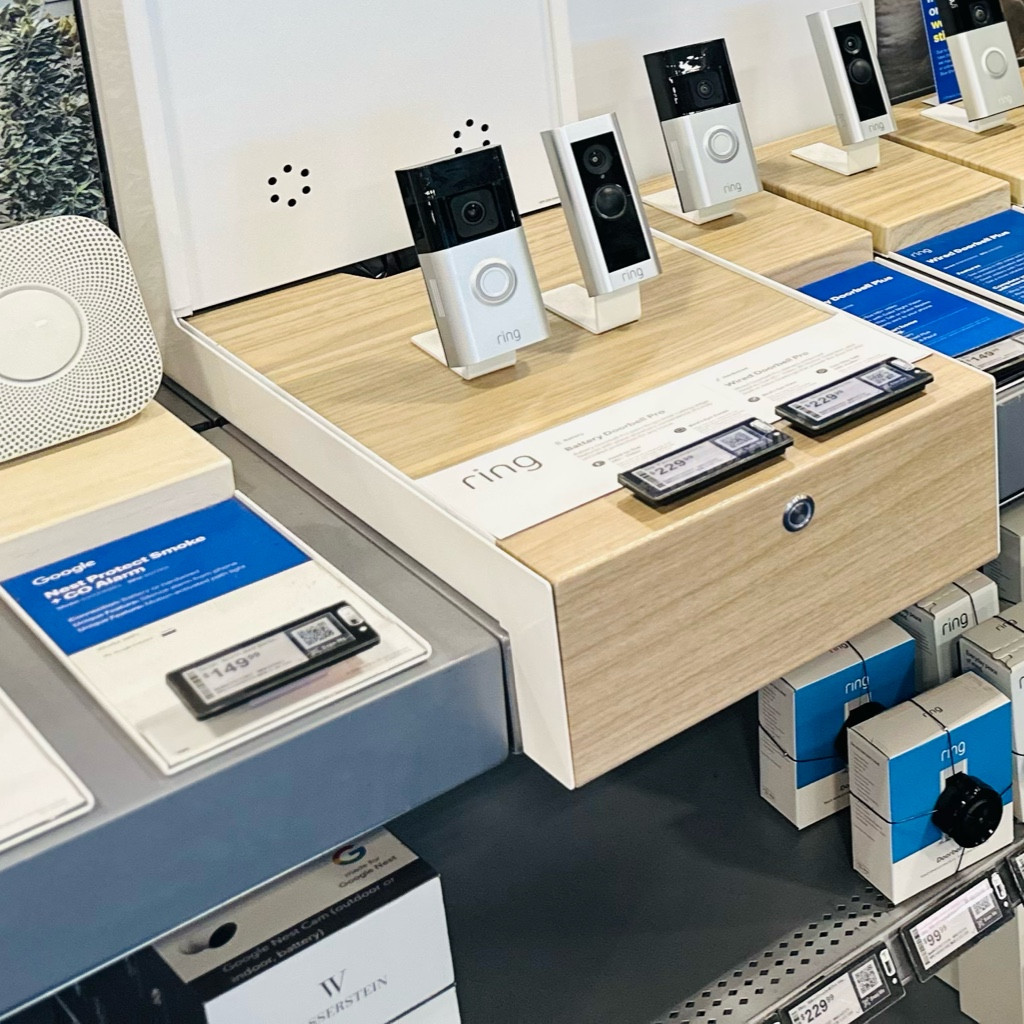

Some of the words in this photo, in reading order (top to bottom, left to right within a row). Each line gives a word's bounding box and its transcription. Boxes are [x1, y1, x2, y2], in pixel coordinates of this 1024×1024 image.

[868, 122, 885, 133] ring
[724, 182, 742, 194] ring
[910, 248, 933, 258] ring
[926, 250, 956, 264] Wired
[955, 238, 991, 255] Doorbell
[990, 231, 1011, 241] Plus
[622, 267, 644, 282] ring
[830, 282, 873, 301] Doorbell
[871, 276, 894, 286] Plus
[497, 328, 521, 344] ring
[725, 374, 754, 388] Wired
[753, 357, 793, 376] Doorbell
[793, 351, 809, 361] Pro
[564, 434, 602, 452] Battery
[603, 416, 646, 438] Doorbell
[647, 410, 666, 420] Pro
[462, 454, 543, 490] ring
[32, 559, 97, 586] Google
[43, 580, 85, 600] Nest
[86, 557, 150, 584] Protect
[149, 535, 206, 560] Smoke
[63, 586, 93, 600] CO
[96, 567, 146, 589] Alarm
[942, 612, 968, 636] ring
[845, 676, 870, 694] ring
[338, 868, 373, 889] Google
[374, 855, 397, 870] Nest
[344, 863, 367, 878] made
[368, 857, 380, 866] for
[222, 944, 270, 973] Google
[271, 929, 300, 947] Nest
[300, 913, 330, 931] Cam
[330, 885, 381, 916] (outdoor
[383, 878, 395, 886] or
[231, 958, 278, 983] indoor,
[276, 929, 325, 959] battery)
